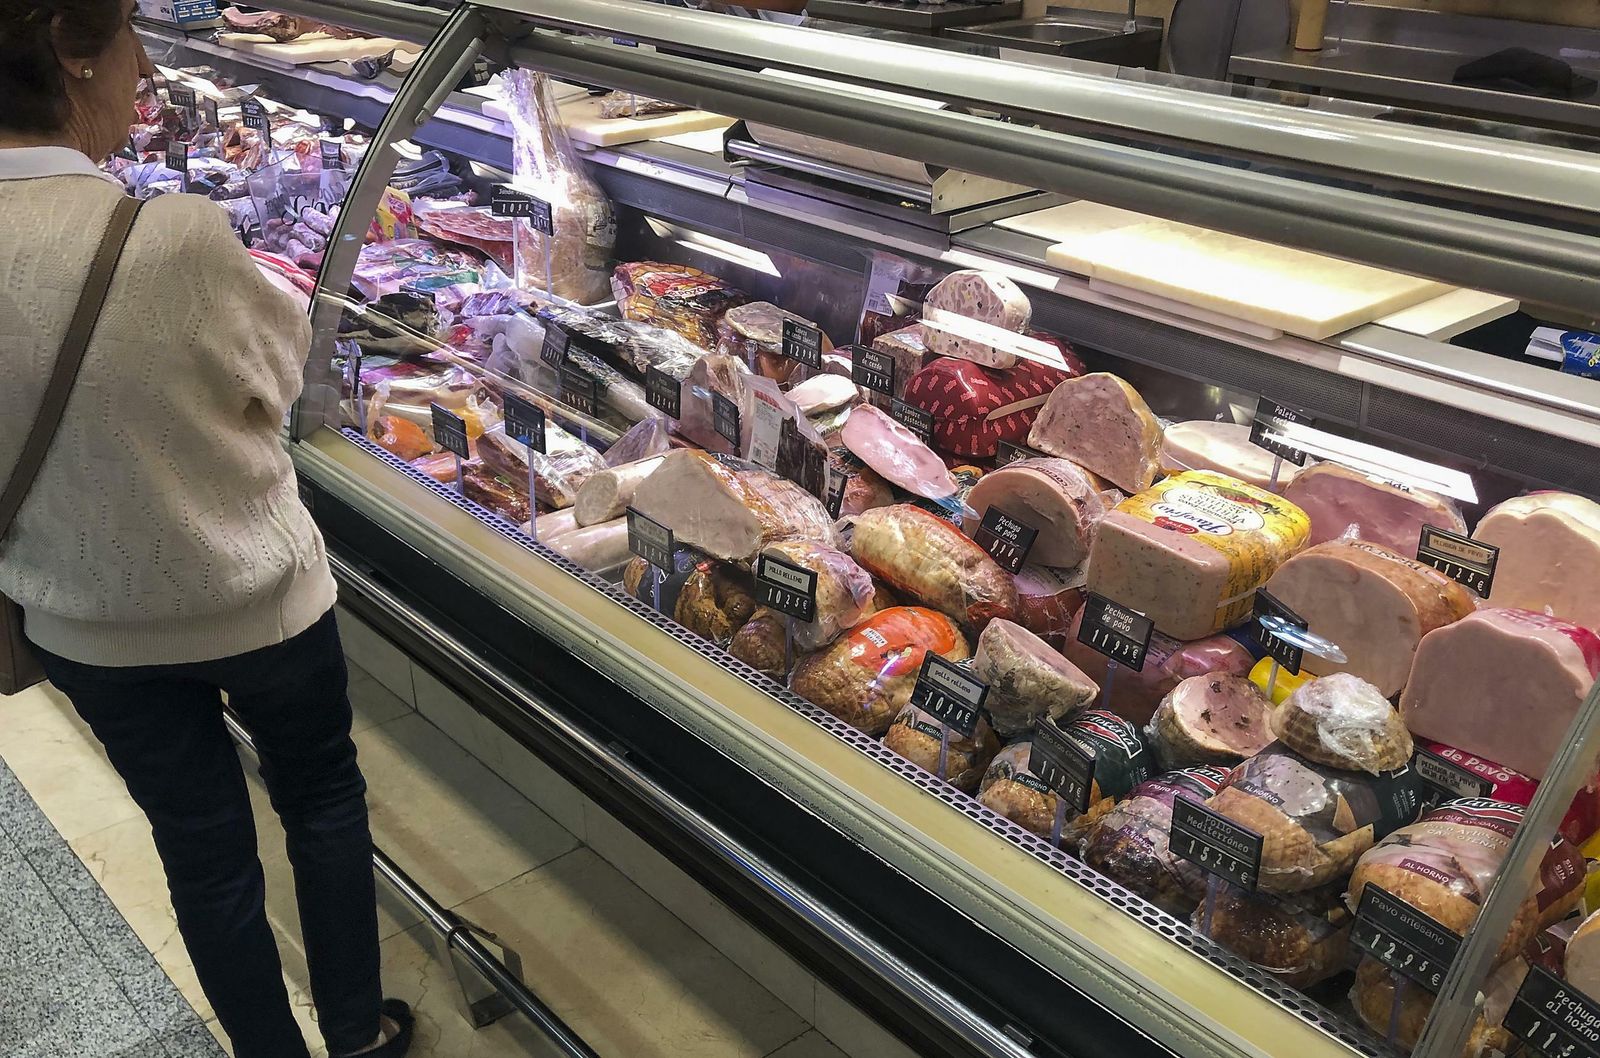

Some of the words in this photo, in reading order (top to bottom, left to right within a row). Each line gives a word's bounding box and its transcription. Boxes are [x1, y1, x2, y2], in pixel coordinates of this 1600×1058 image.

[868, 360, 882, 370] cerdo
[894, 410, 903, 418] con
[903, 414, 928, 430] pistachos
[1274, 404, 1297, 421] Paleta
[994, 523, 1003, 533] de
[1002, 529, 1018, 541] pavo
[998, 515, 1022, 533] Pechuga
[1101, 613, 1111, 623] de
[1112, 620, 1131, 632] pavo
[1104, 603, 1134, 624] Pechuga
[1441, 749, 1463, 762] de
[1464, 756, 1510, 782] Pavo
[1017, 775, 1026, 783] AL
[1025, 776, 1048, 791] HORNO
[1244, 785, 1254, 793] AL
[1253, 788, 1279, 804] HORNO
[1186, 815, 1249, 853] Mediterráneo
[1205, 815, 1232, 835] Pollo
[1405, 861, 1415, 869] AL
[1416, 864, 1449, 883] HORNO
[1371, 896, 1398, 917] Pavo
[1399, 912, 1445, 946] artesano
[1554, 989, 1600, 1029] Pechuga
[1545, 1000, 1562, 1015] al
[1564, 1011, 1600, 1042] horno
